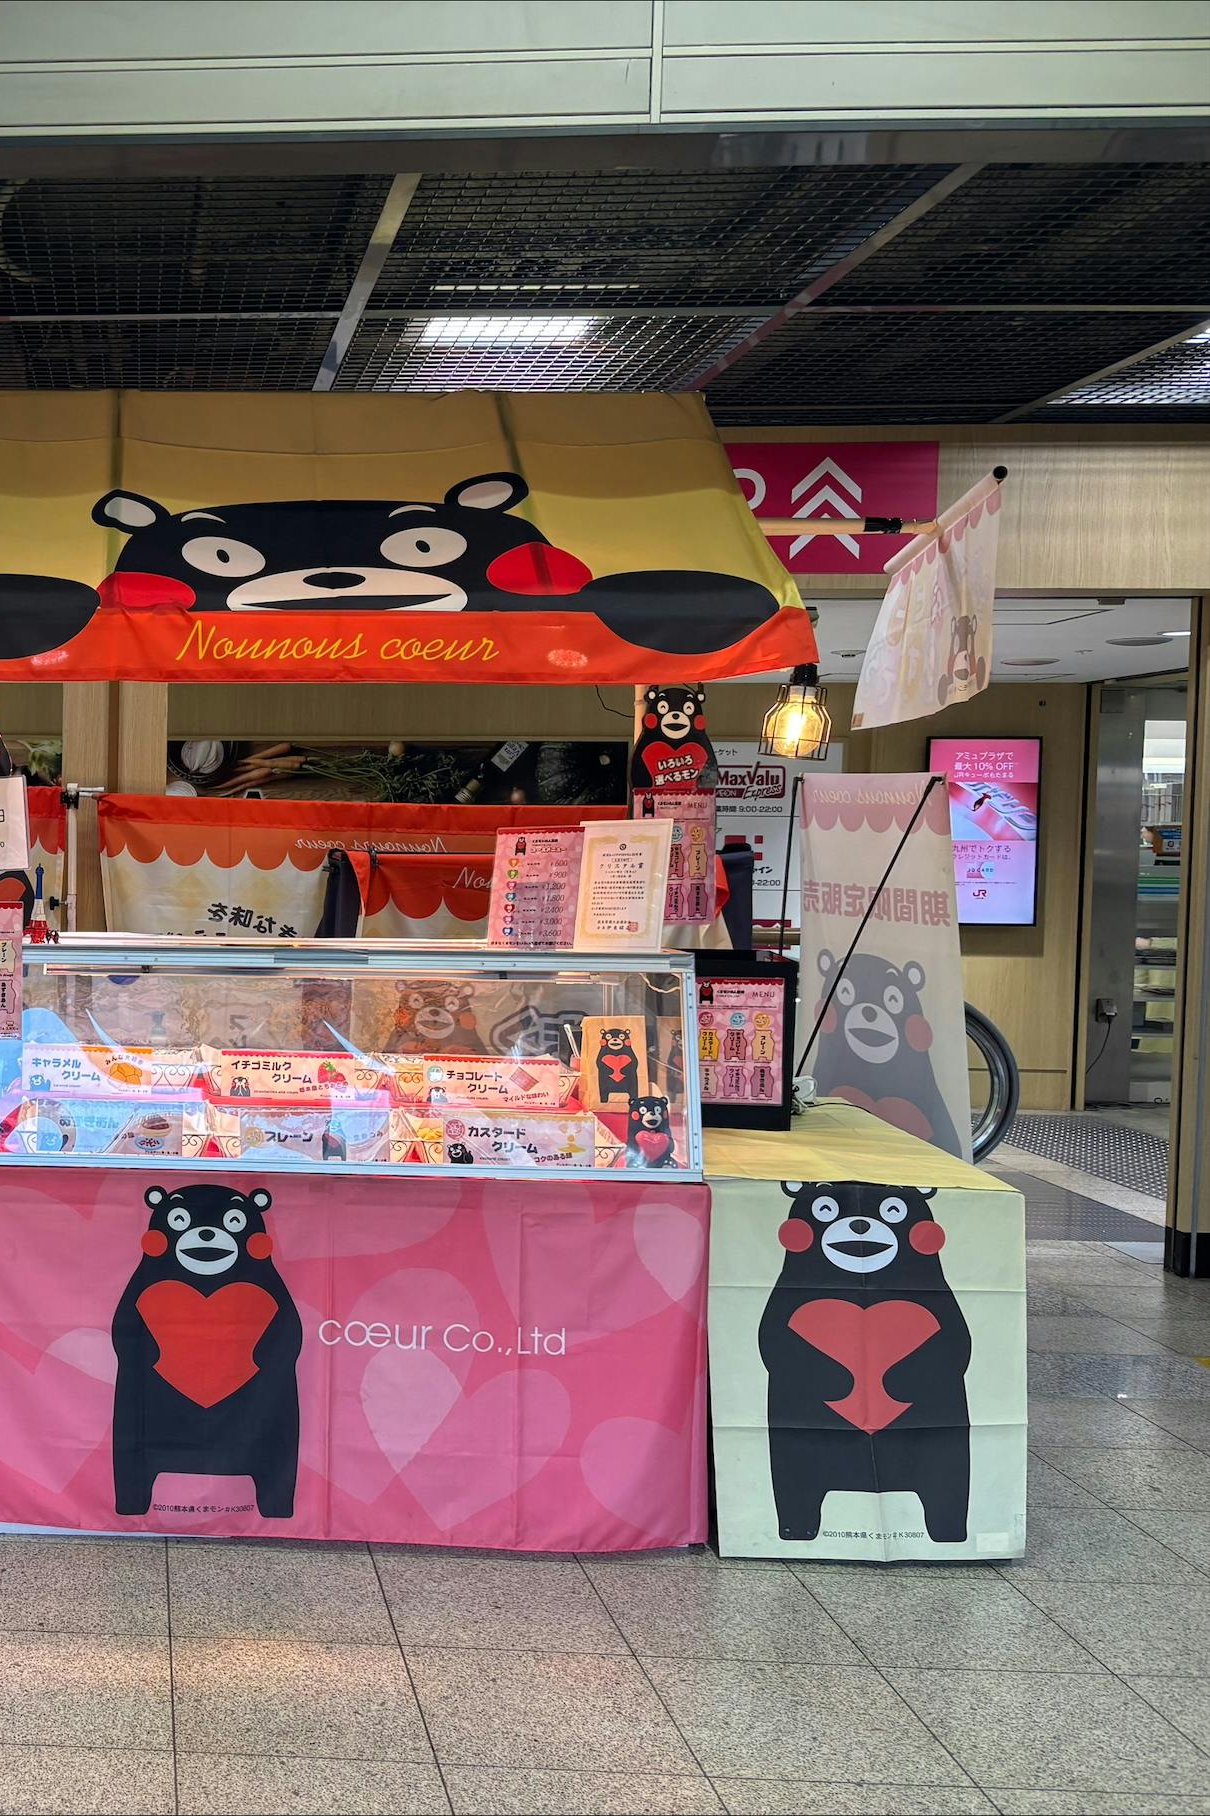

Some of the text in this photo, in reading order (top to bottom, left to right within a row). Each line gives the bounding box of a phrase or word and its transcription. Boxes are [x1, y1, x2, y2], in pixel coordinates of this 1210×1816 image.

[658, 755, 693, 771] いろいろ
[996, 762, 1014, 771] OFF
[654, 768, 699, 787] 選べるモン
[32, 1057, 82, 1069] キャラメル
[231, 1060, 292, 1071] イチゴミルク
[61, 1070, 101, 1082] クリーム
[271, 1073, 312, 1084] クリーム
[446, 1070, 503, 1082] チョコレート
[467, 1083, 508, 1094] クリーム
[264, 1131, 313, 1143] プレーン
[468, 1126, 526, 1139] カスタード
[491, 1141, 538, 1154] クリーム
